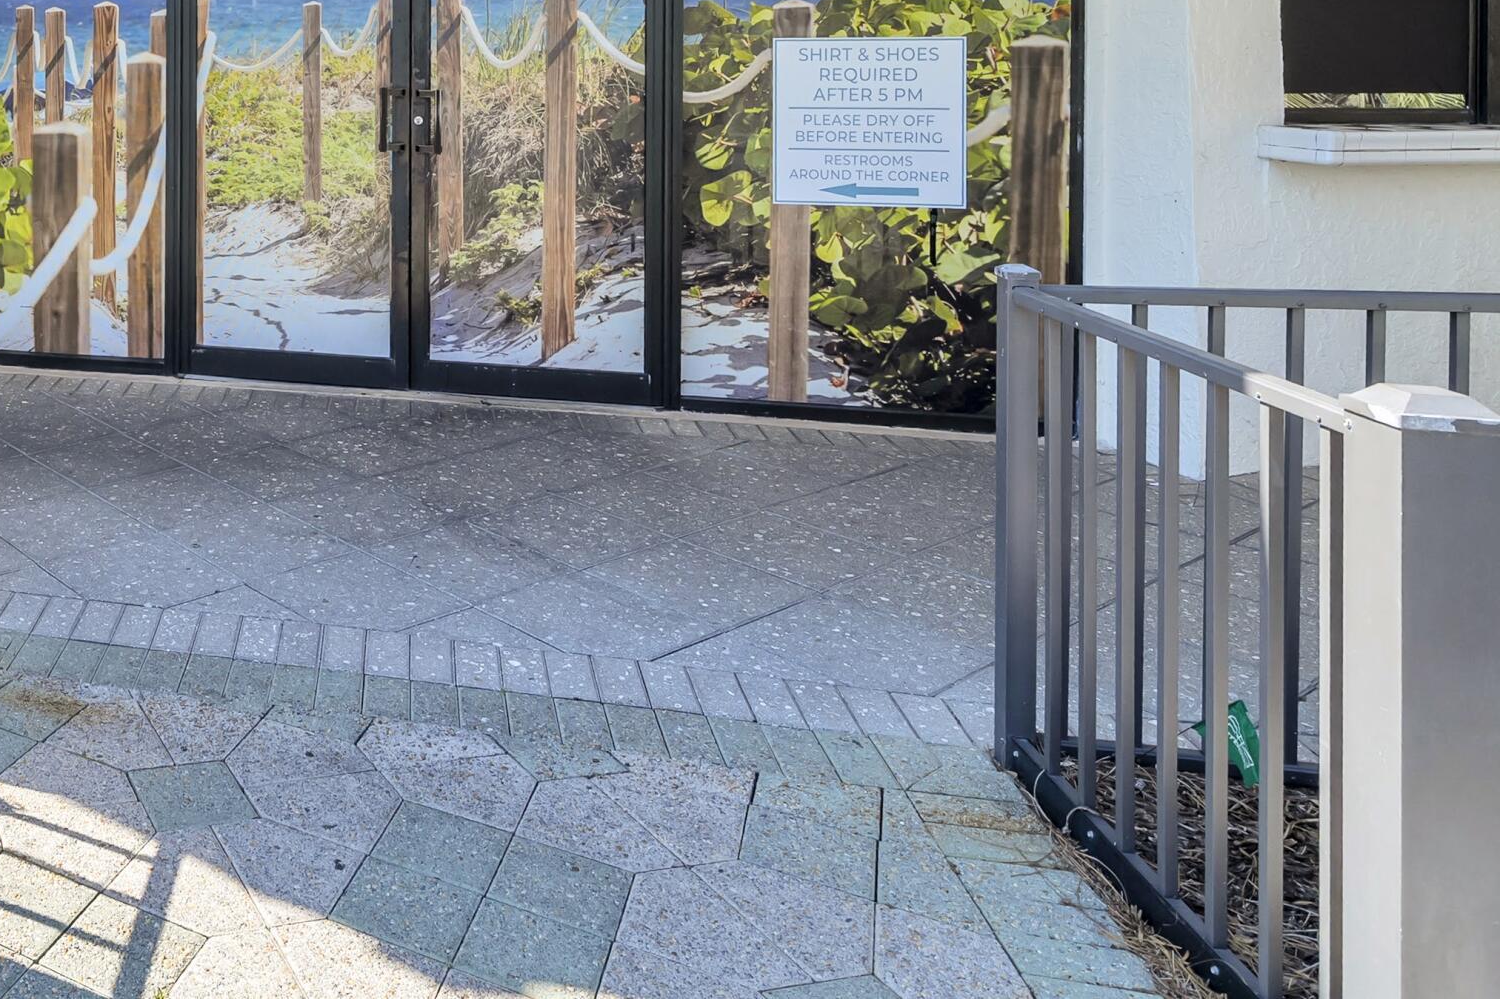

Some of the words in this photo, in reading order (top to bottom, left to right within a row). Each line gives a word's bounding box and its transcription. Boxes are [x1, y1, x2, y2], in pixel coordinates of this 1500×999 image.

[798, 47, 852, 62] SHIRT
[857, 47, 870, 62] &
[875, 47, 940, 62] SHOES
[819, 67, 918, 84] REQUIRED
[813, 87, 872, 102] AFTER
[878, 88, 888, 102] 5
[894, 88, 923, 102] PM
[803, 114, 861, 127] PLEASE
[866, 114, 899, 127] DRY
[903, 114, 936, 128] OFF
[795, 130, 857, 143] BEFORE
[862, 131, 943, 144] ENTERING
[824, 154, 913, 167] RESTROOMS
[789, 168, 852, 181] AROUND
[855, 169, 883, 181] THE
[888, 170, 949, 183] CORNER
